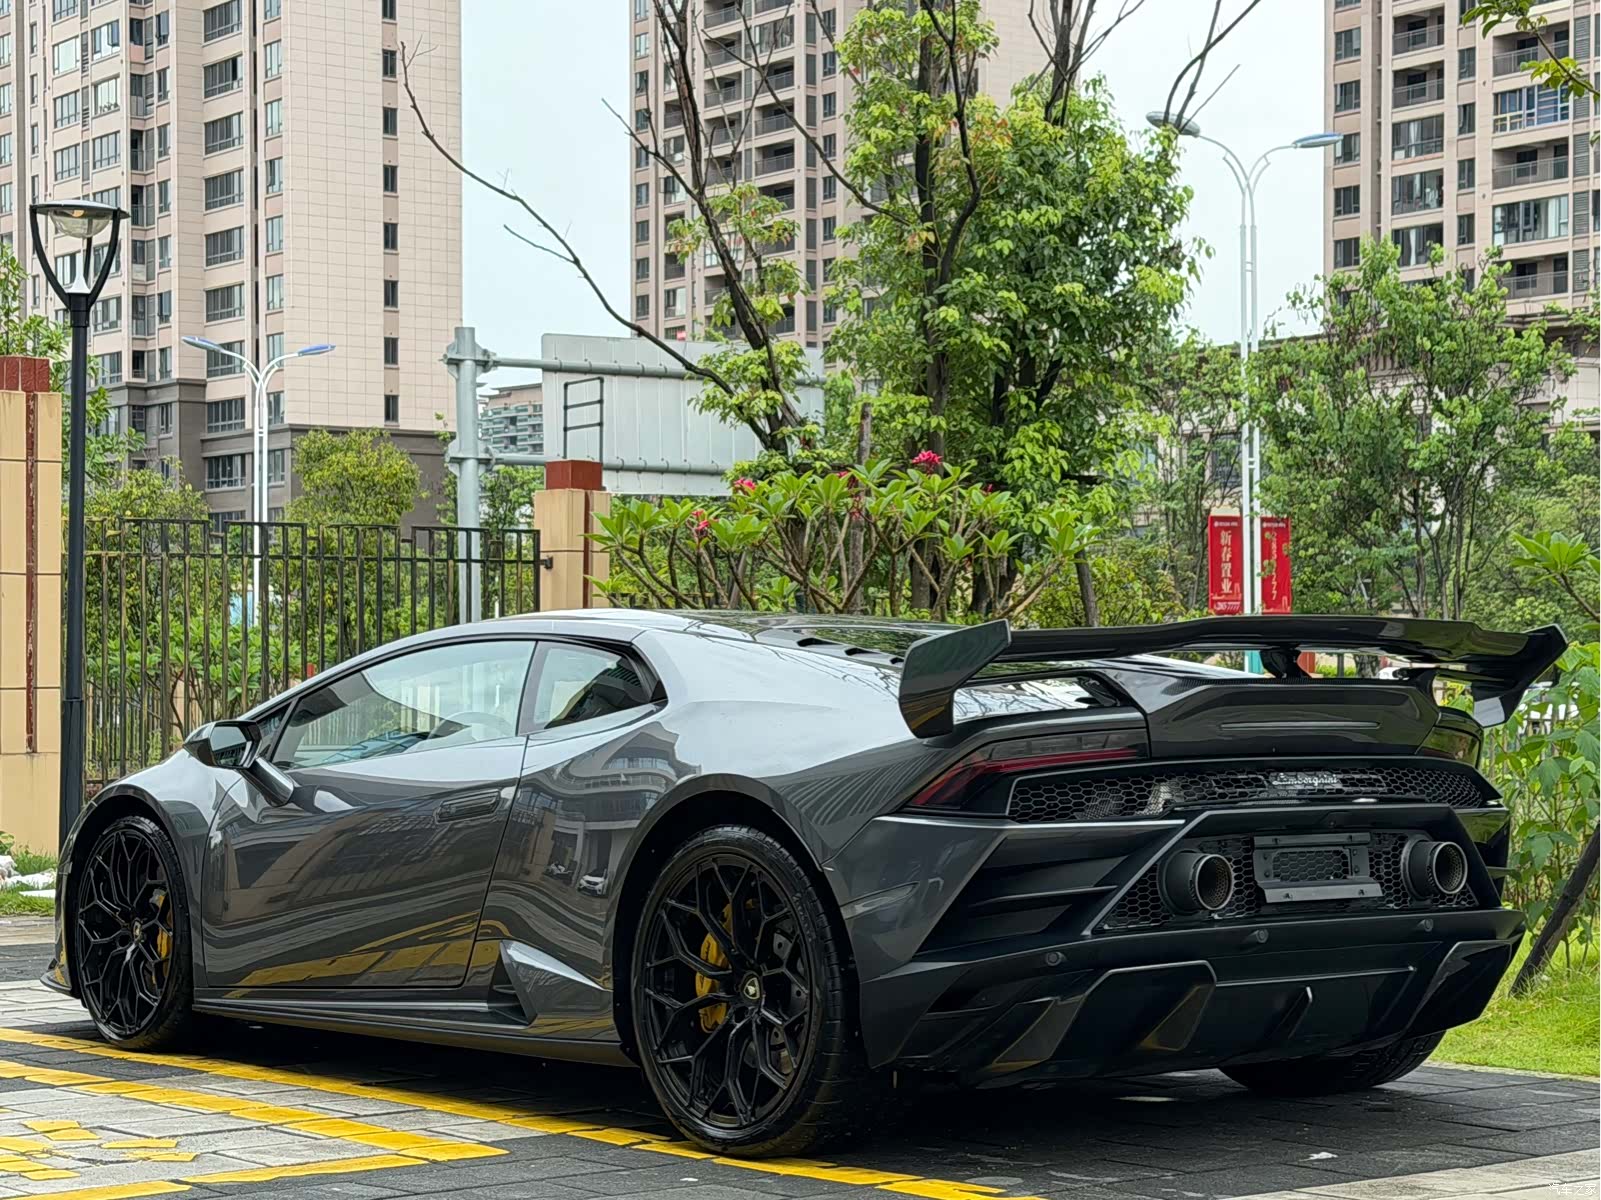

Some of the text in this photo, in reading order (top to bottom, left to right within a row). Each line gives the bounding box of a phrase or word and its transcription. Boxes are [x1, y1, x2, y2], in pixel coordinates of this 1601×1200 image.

[1220, 530, 1233, 594] 新春置业
[1271, 772, 1337, 787] Lamborghini
